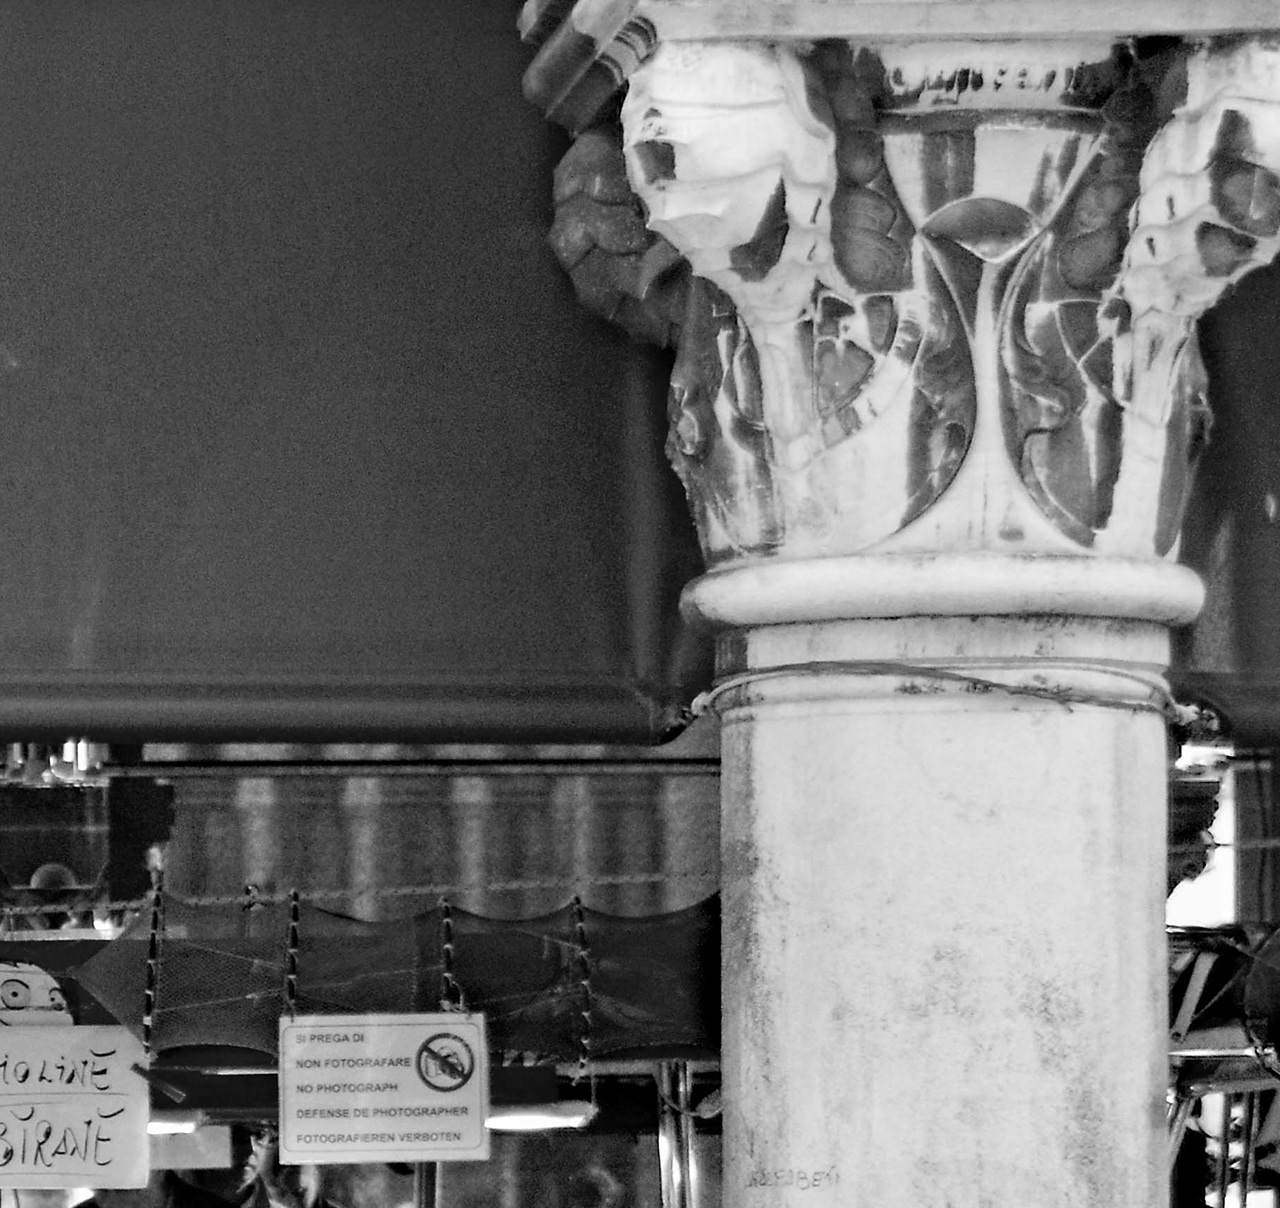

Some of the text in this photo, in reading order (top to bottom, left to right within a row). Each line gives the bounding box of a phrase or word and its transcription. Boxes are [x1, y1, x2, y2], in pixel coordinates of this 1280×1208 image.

[296, 1033, 364, 1043] SI PREGA DI
[296, 1057, 411, 1069] NON FOTOGRAFARE
[296, 1083, 399, 1093] NO PHOTOGRAPH
[296, 1106, 469, 1118] DEFENSE DE PHOTOGRAPHER
[296, 1132, 462, 1144] FOTOGRAFIEREN VERBOTEN
